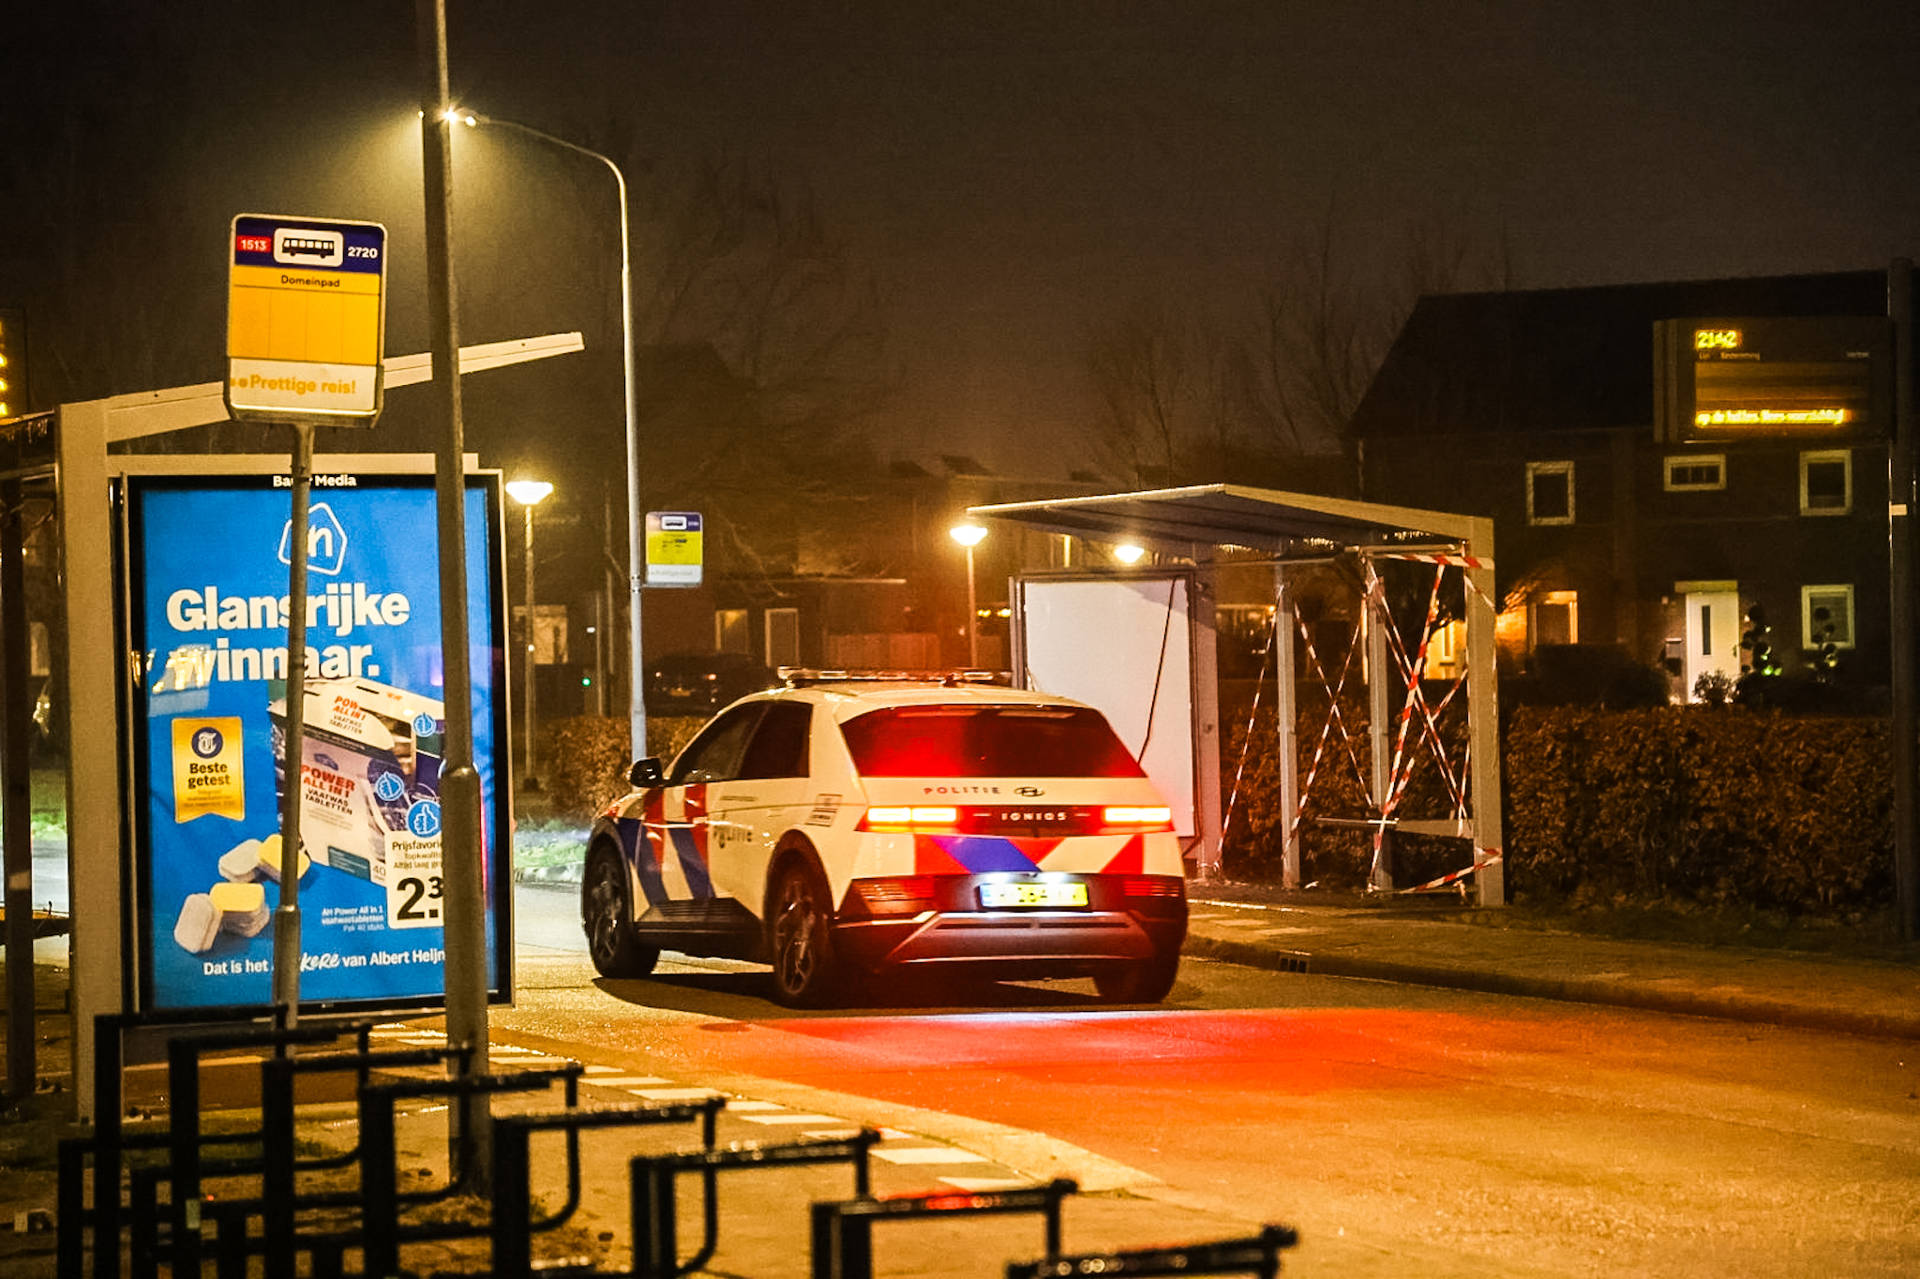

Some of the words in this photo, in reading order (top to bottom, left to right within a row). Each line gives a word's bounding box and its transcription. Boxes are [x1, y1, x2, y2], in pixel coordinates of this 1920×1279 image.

[240, 239, 267, 251] 1513
[347, 246, 378, 259] 2720
[280, 274, 340, 288] Domeinpad
[250, 374, 317, 396] Prettige
[321, 380, 356, 395] reis!
[314, 474, 357, 487] Media
[334, 695, 359, 710] POW
[190, 762, 228, 774] Beste
[188, 774, 231, 790] getest
[300, 764, 355, 791] POWER
[303, 777, 326, 791] ALL
[329, 784, 343, 797] IN
[923, 786, 1000, 795] POLITIE
[305, 794, 353, 815] TABLETTEN
[307, 788, 349, 807] VAATWAS
[392, 840, 443, 852] Prijsfavori
[404, 852, 442, 860] Topkwalit
[397, 876, 444, 920] 2.3
[203, 960, 229, 976] Dat
[230, 959, 243, 974] is
[245, 959, 269, 974] het
[342, 954, 367, 968] van
[369, 950, 411, 966] Albert
[412, 948, 446, 964] Heijn
